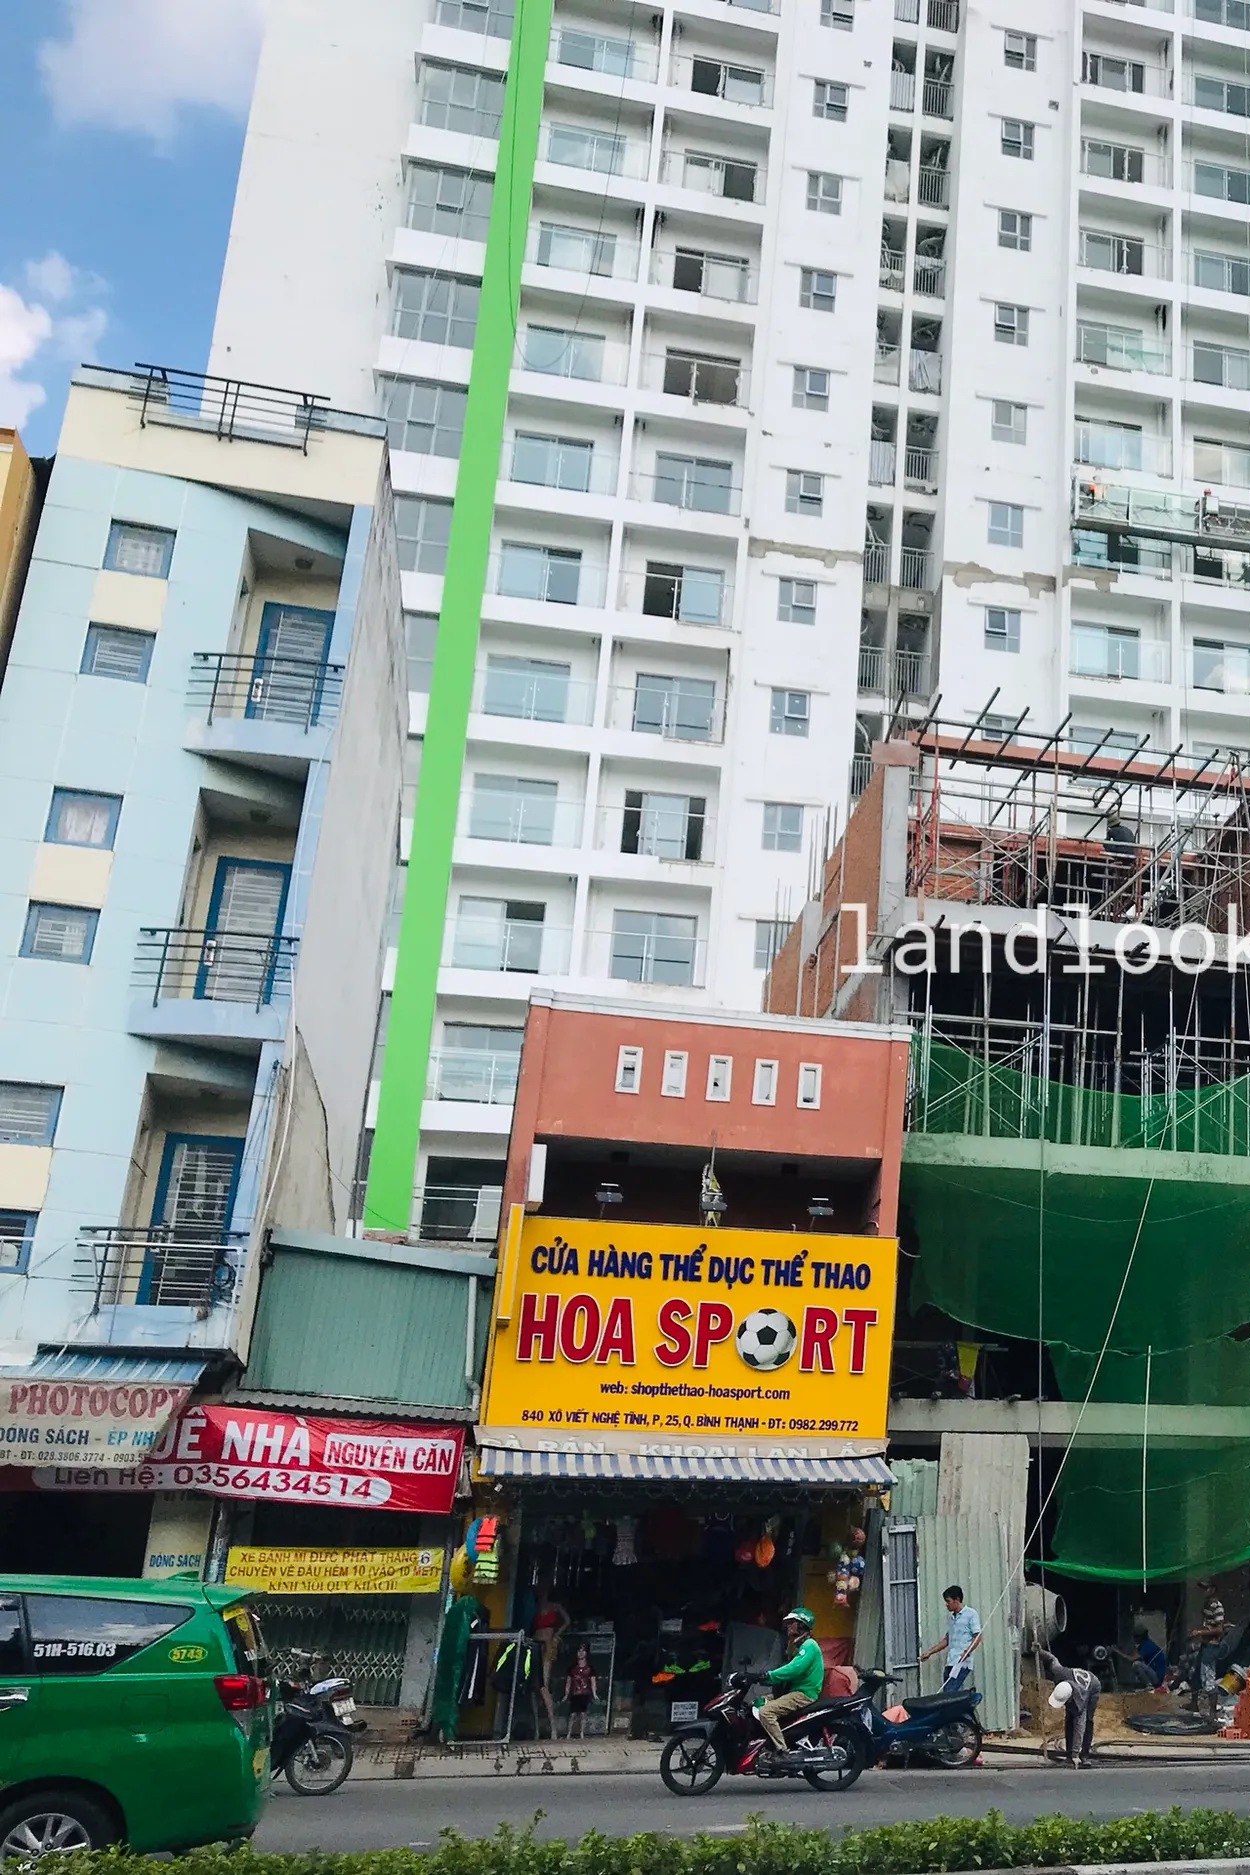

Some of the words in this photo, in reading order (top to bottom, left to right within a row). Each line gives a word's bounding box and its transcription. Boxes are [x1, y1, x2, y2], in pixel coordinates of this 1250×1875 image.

[531, 1236, 579, 1275] CỬA
[587, 1244, 652, 1280] HÀNG
[659, 1244, 707, 1282] THỂ
[709, 1256, 754, 1289] DỤC
[761, 1249, 809, 1287] THỂ
[811, 1262, 871, 1290] THAO
[516, 1292, 637, 1366] HOA
[8, 1383, 190, 1418] PHOTOCOPY
[600, 1381, 629, 1395] web:
[631, 1382, 790, 1401] shopthethao-hoasport.com
[521, 1410, 544, 1421] 840
[548, 1409, 563, 1422] XÔ
[565, 1408, 589, 1422] VIẾT
[592, 1411, 620, 1427] NGHỆ
[696, 1412, 720, 1427] BÌNH
[724, 1416, 759, 1432] THẠNH
[788, 1418, 859, 1432] 0982.299.772
[45, 1424, 90, 1446] SÁCH
[107, 1427, 128, 1446] ÉP
[222, 1416, 311, 1467] NHÀ
[327, 1439, 405, 1470] NGUYÊN
[412, 1441, 451, 1473] CĂN
[174, 1465, 371, 1500] 0356434514
[241, 1552, 254, 1563] XE
[421, 1552, 430, 1564] 6
[353, 1565, 365, 1576] 10
[33, 1643, 117, 1657] 51H-516.03
